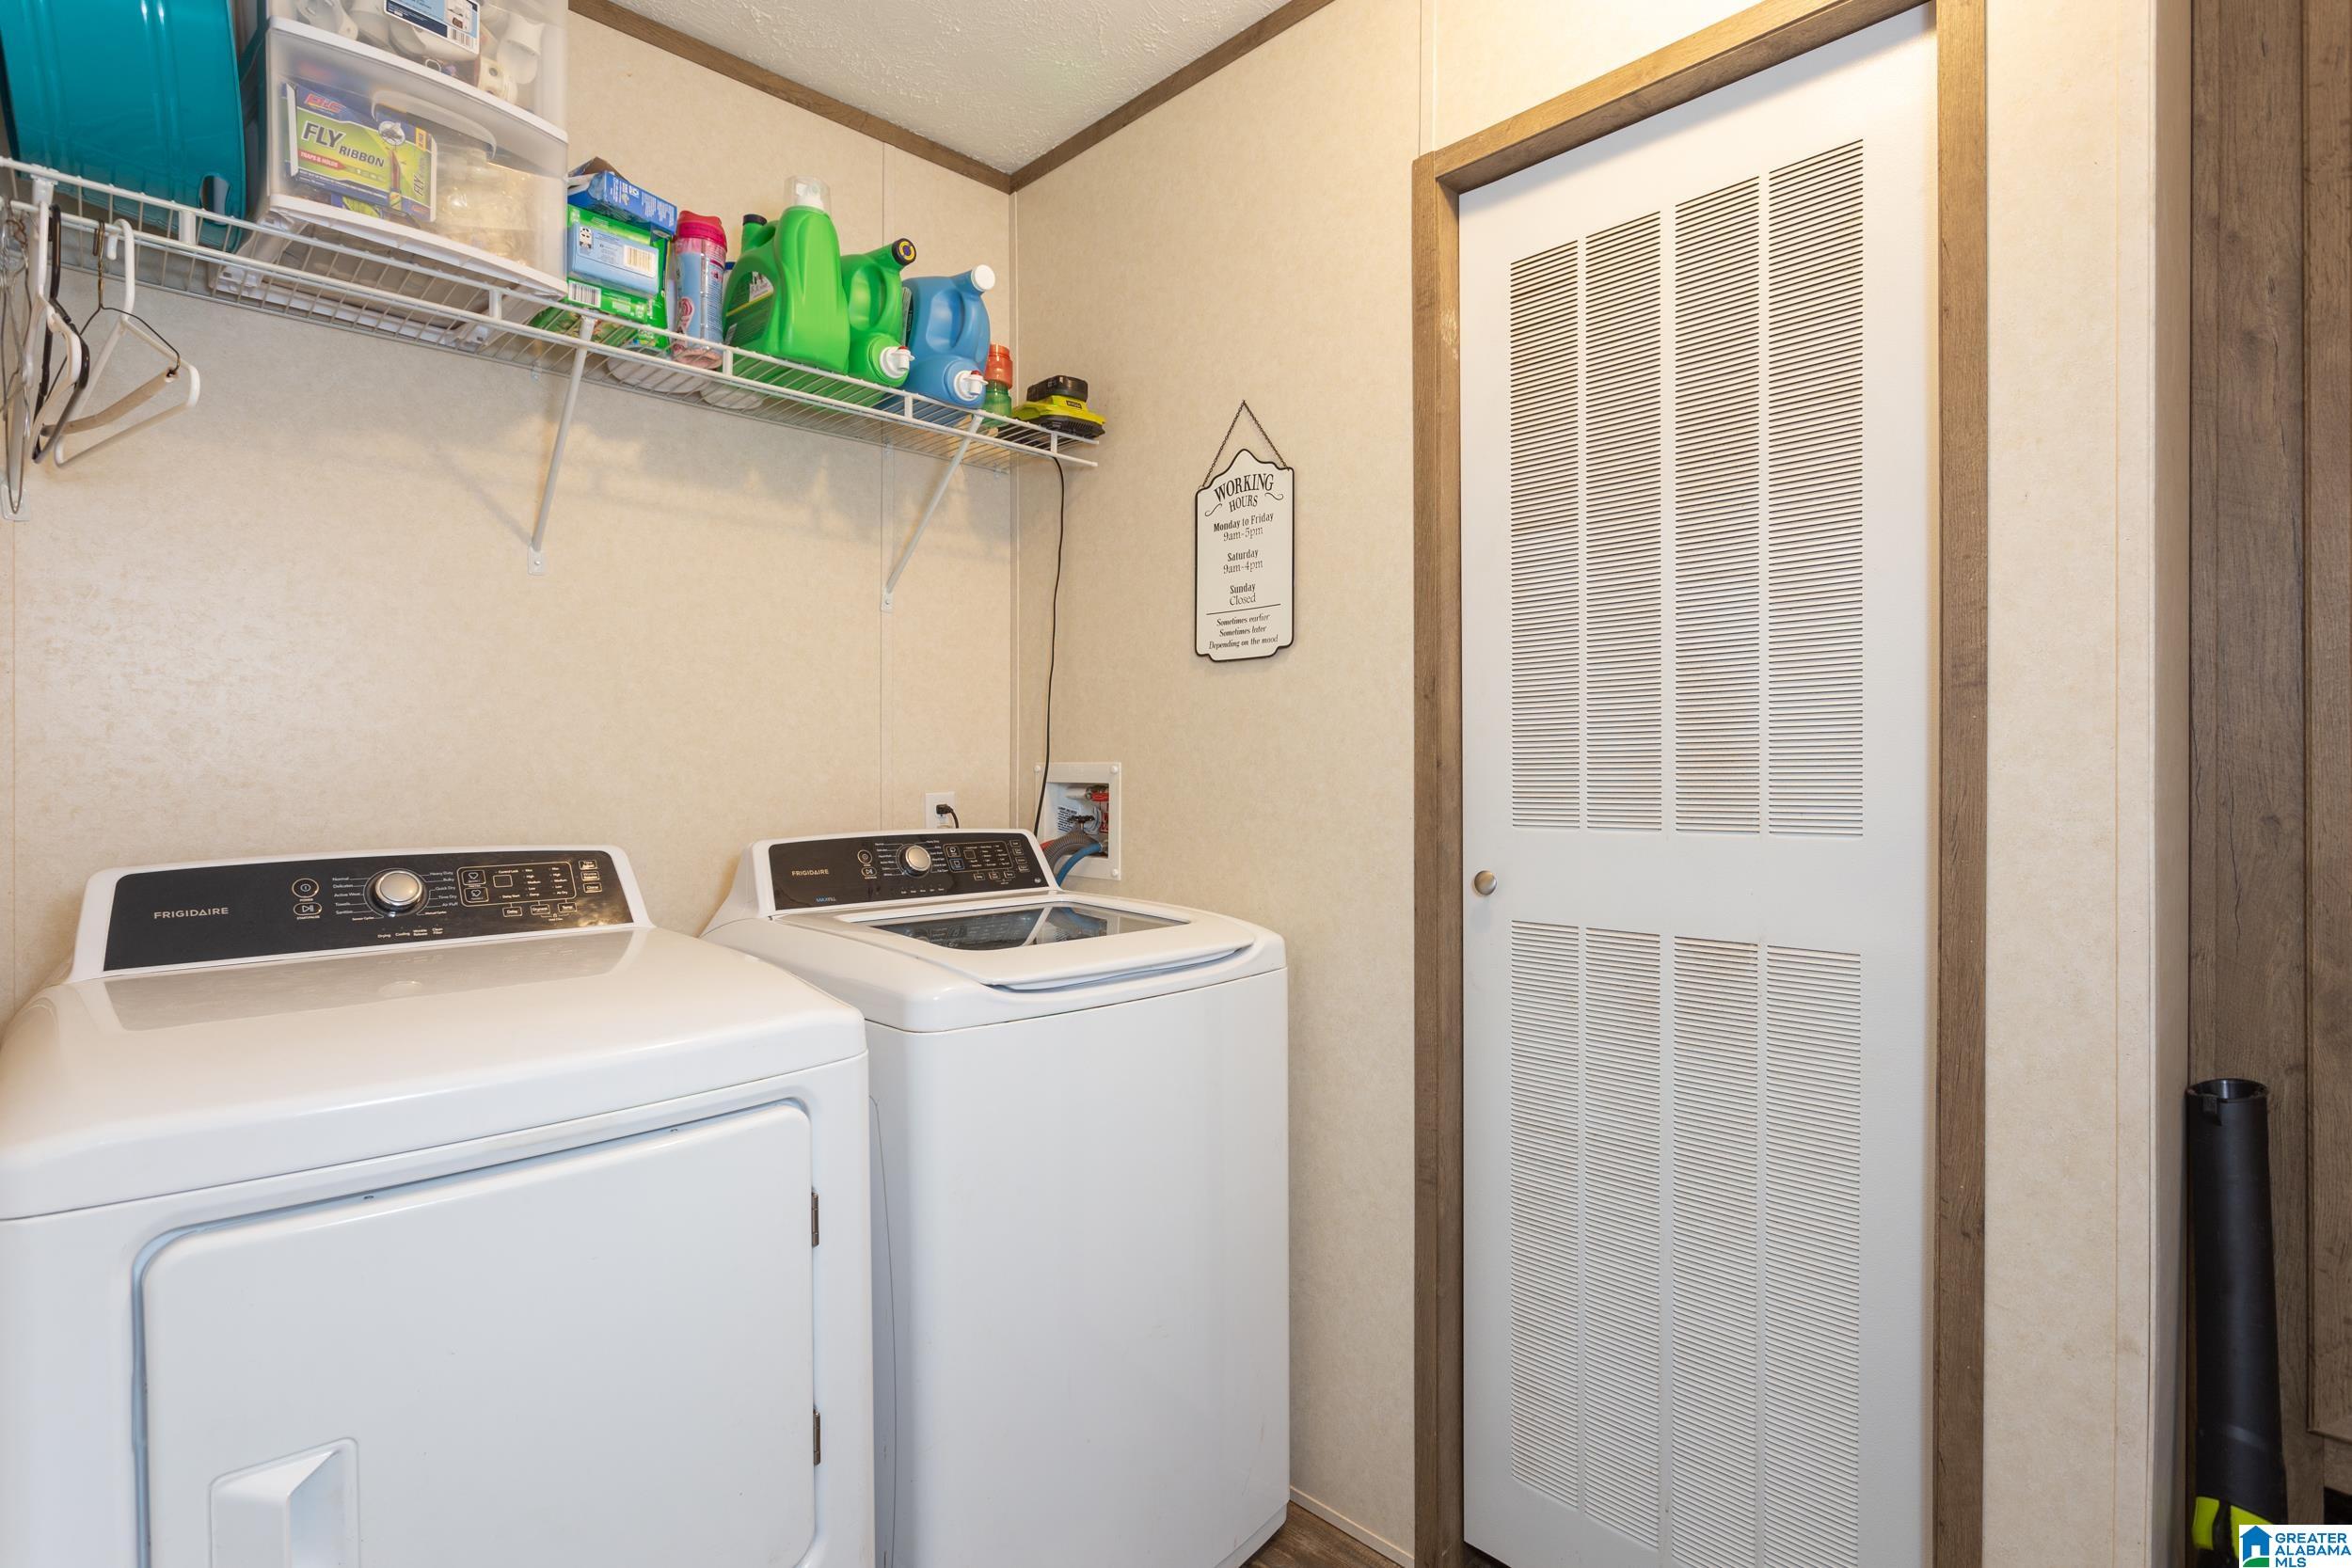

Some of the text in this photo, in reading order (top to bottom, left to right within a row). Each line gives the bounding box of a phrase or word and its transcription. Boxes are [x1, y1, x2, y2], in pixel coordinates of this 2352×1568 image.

[302, 121, 345, 150] FLY
[339, 146, 384, 166] RIBBON
[414, 173, 424, 197] FLY
[1214, 473, 1274, 502] WORKING
[1229, 495, 1258, 512] HOURS
[1214, 513, 1274, 532] Monday to Friday
[1223, 527, 1263, 542] 9am-5pm
[1227, 549, 1258, 562] Saturday
[1223, 560, 1263, 574] 9am-4pm
[1230, 583, 1256, 594] Sunday
[1230, 593, 1256, 606] Closed
[1216, 616, 1248, 626] Sometimes
[1219, 627, 1250, 637] Sometimes
[1209, 639, 1240, 651] Depending
[1250, 637, 1260, 646] the
[792, 868, 829, 877] FRIGIDAIRE
[153, 907, 229, 919] FRIGIDAIRE
